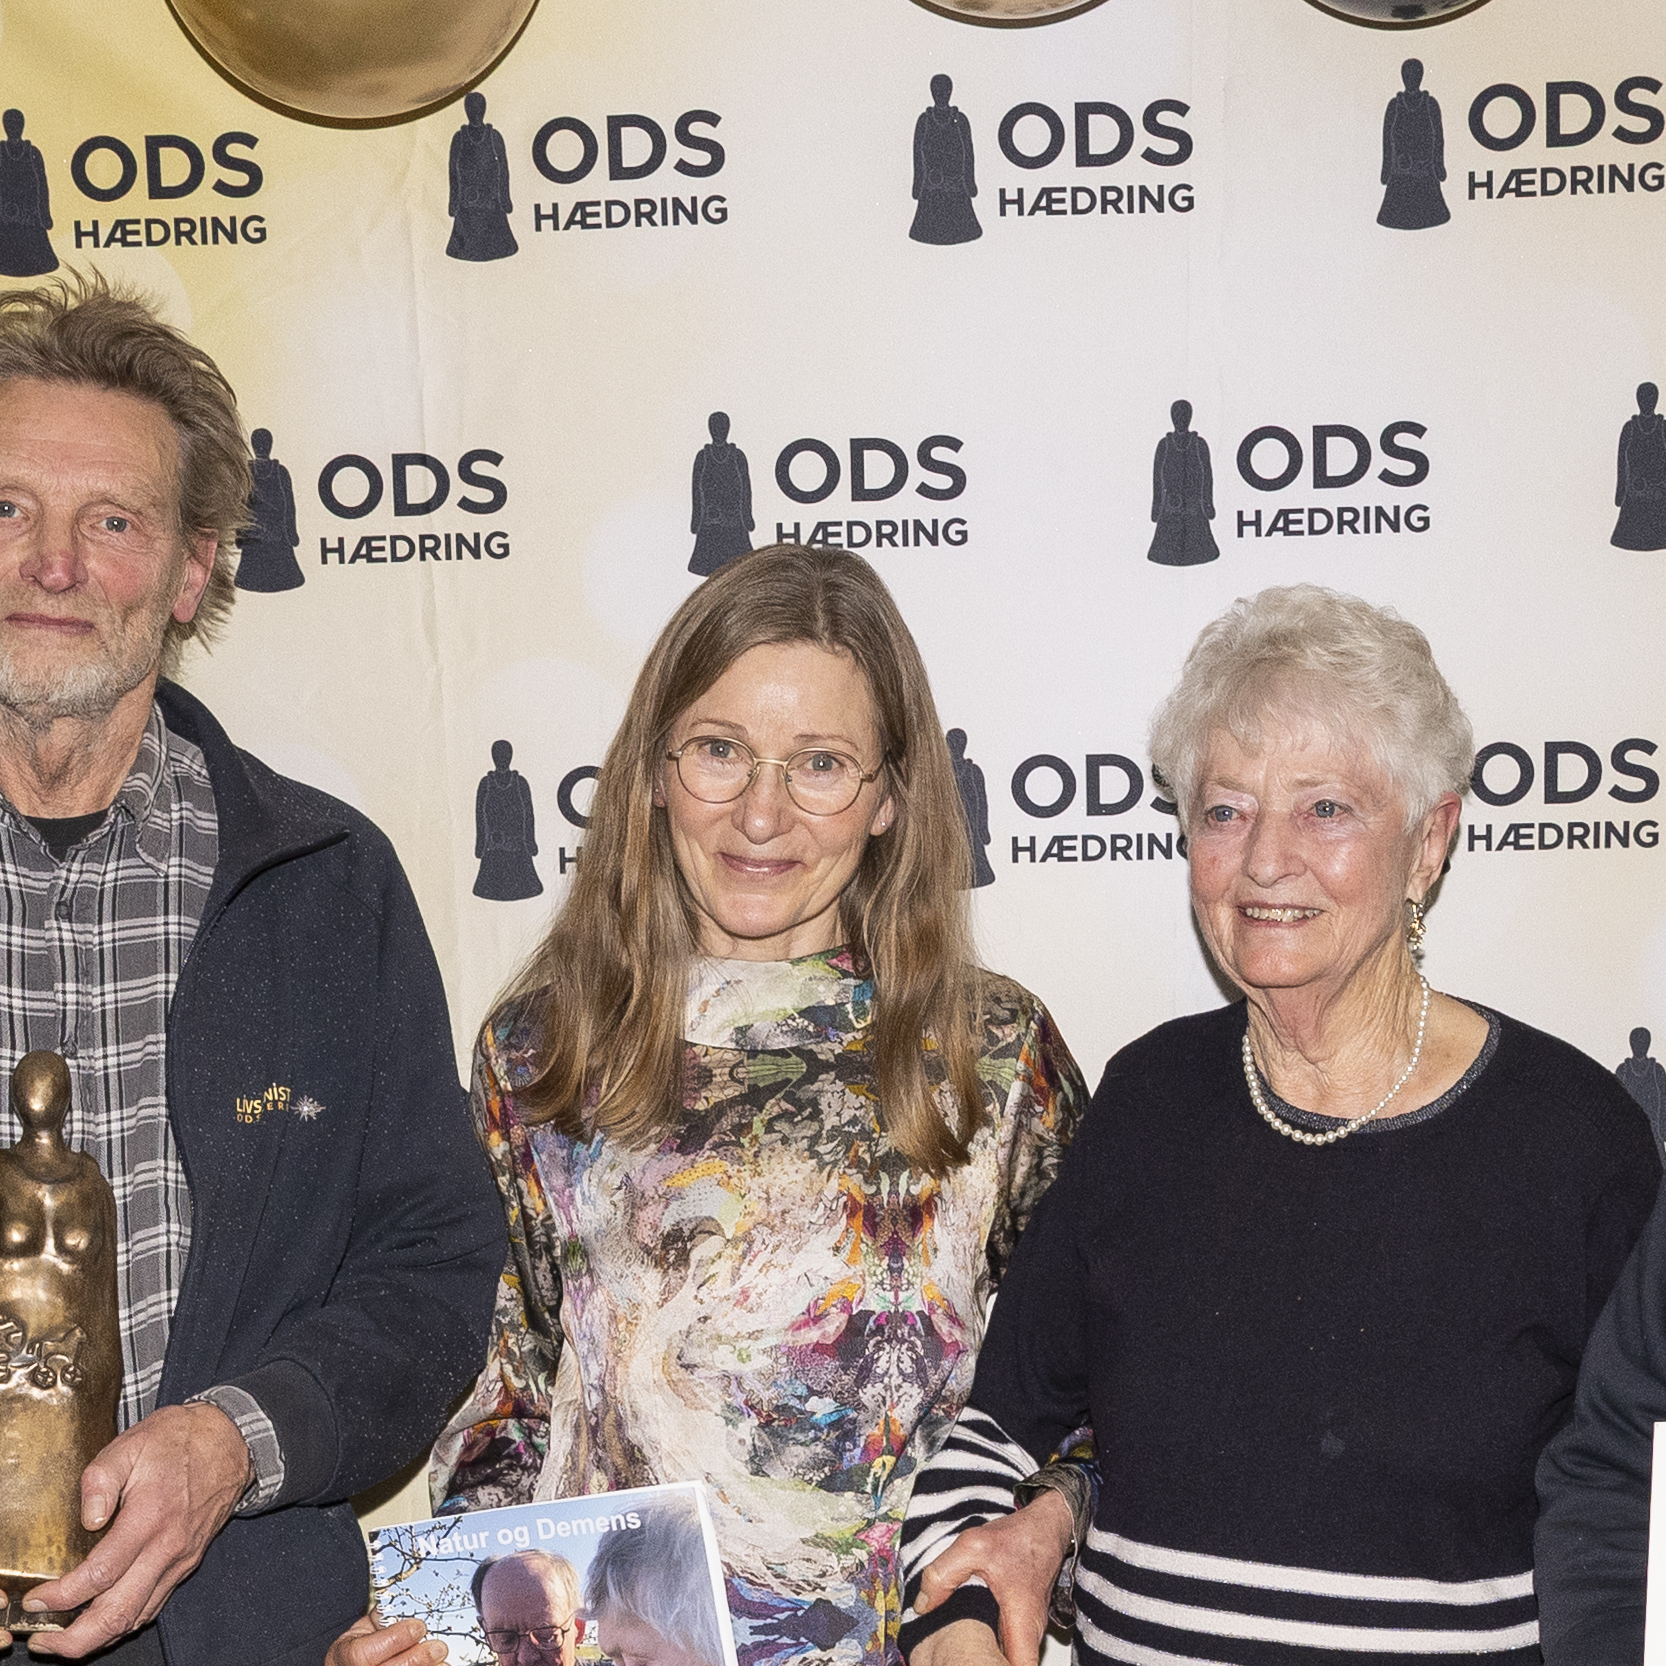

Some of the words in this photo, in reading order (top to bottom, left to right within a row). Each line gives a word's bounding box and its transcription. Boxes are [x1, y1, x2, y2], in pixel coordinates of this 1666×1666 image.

[998, 99, 1193, 169] ODS
[1468, 76, 1665, 151] ODS
[71, 132, 263, 202] ODS
[532, 110, 725, 184] ODS
[999, 184, 1194, 216] HÆDRING
[1469, 162, 1664, 200] HÆDRING
[74, 215, 266, 248] HÆDRING
[534, 195, 727, 232] HÆDRING
[775, 435, 967, 504] ODS
[1237, 421, 1429, 491] ODS
[318, 449, 507, 519] ODS
[776, 518, 968, 549] HÆDRING
[1237, 504, 1430, 538] HÆDRING
[320, 531, 509, 564] HÆDRING
[1469, 738, 1659, 806] ODS
[1468, 820, 1659, 851] HÆDRING
[418, 1530, 489, 1557] Natur
[497, 1525, 530, 1548] og
[536, 1511, 642, 1541] Demens
